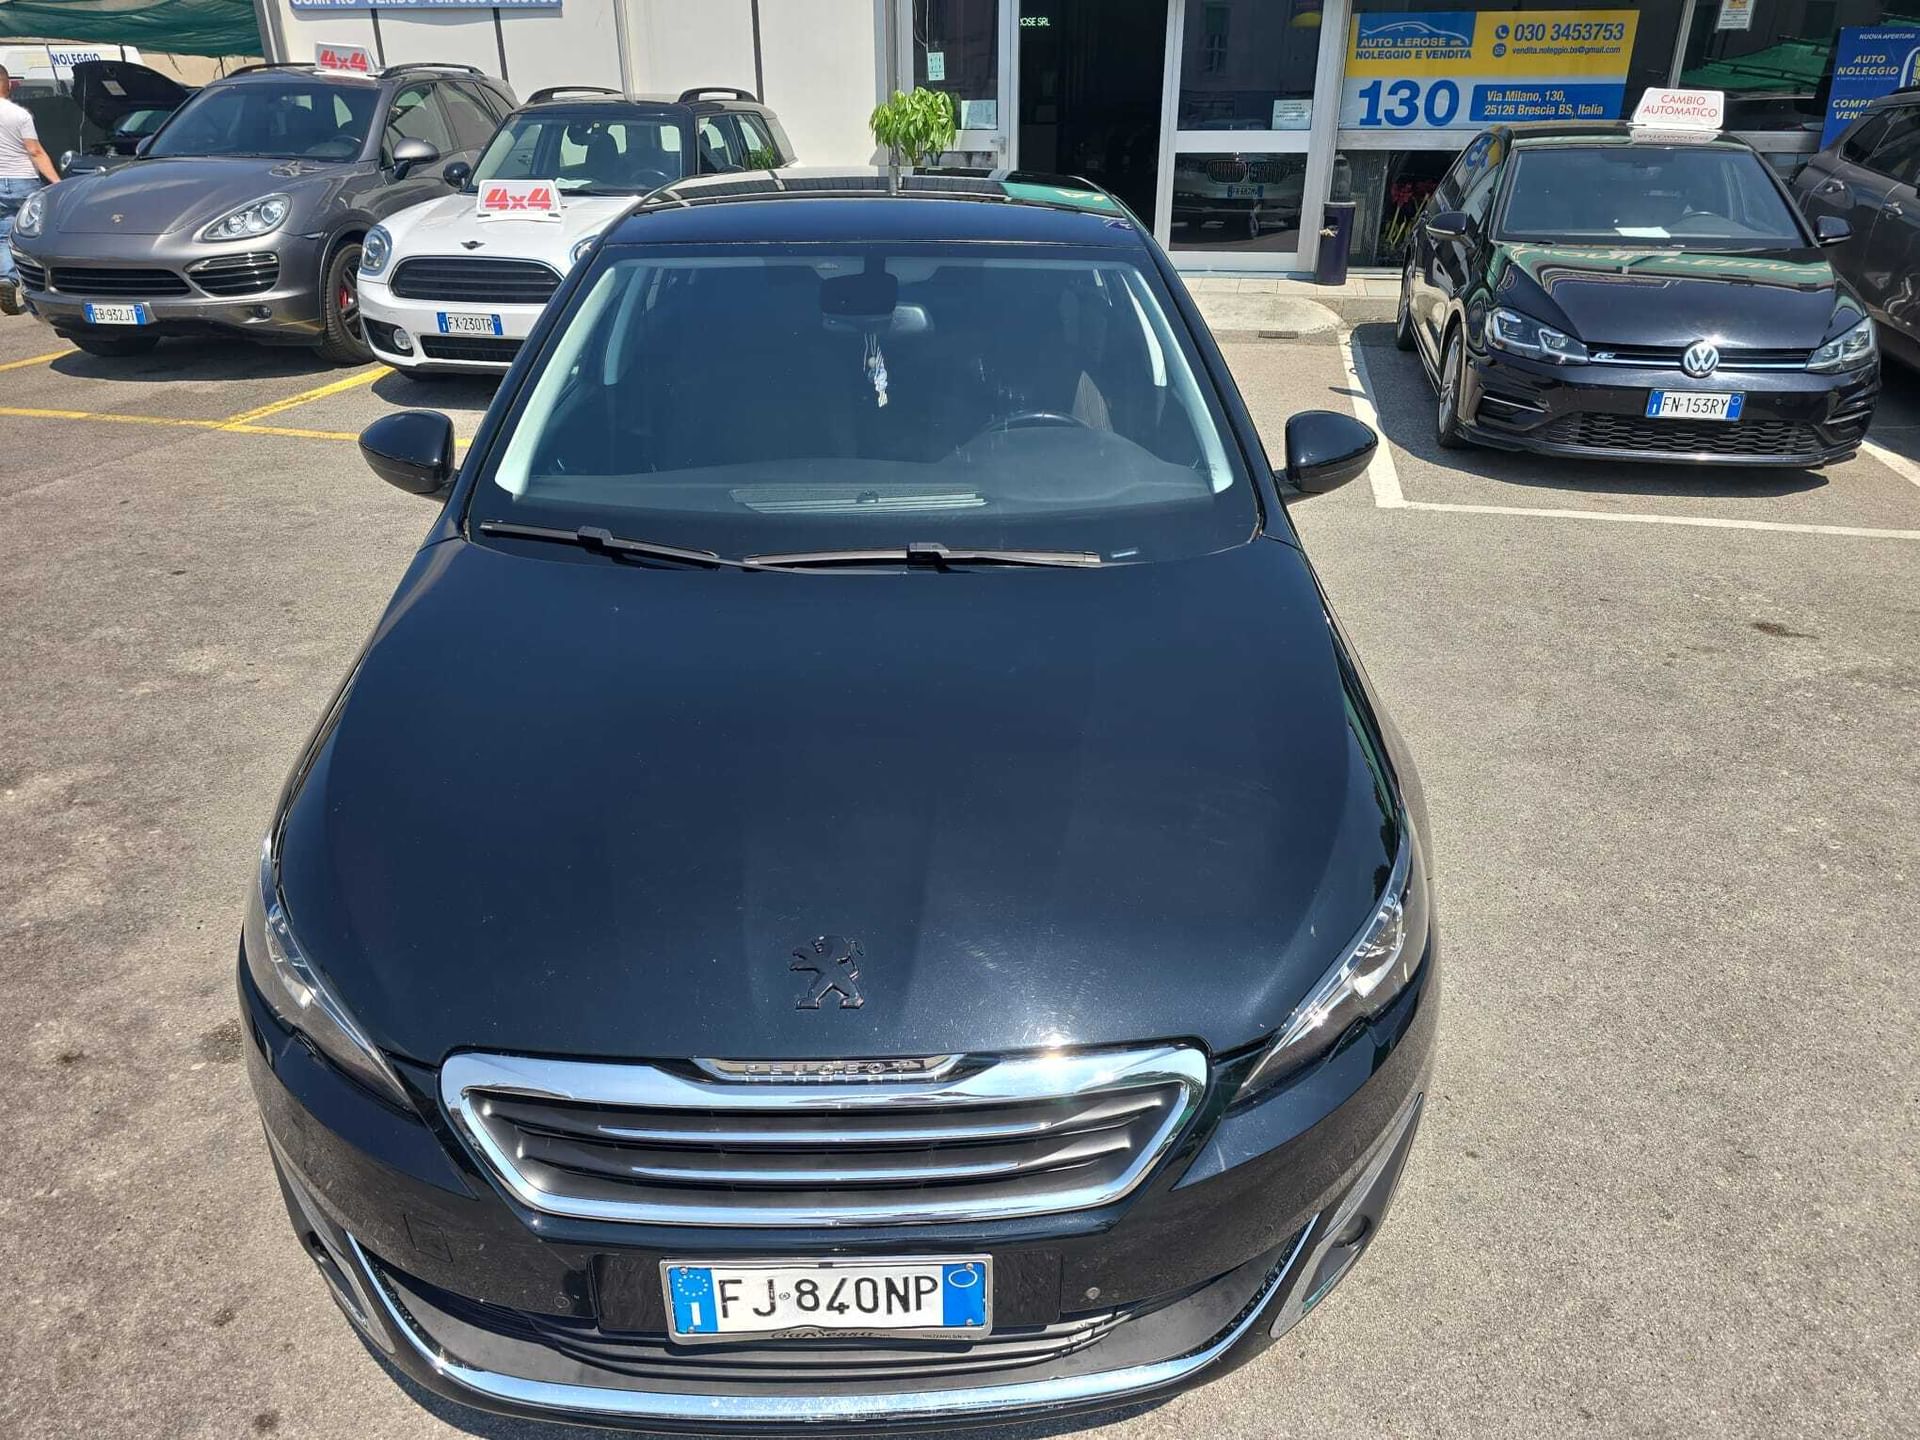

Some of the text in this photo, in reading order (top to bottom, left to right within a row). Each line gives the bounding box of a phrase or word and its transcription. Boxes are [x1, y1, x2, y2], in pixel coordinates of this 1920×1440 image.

[1037, 17, 1050, 26] SRL
[1514, 23, 1625, 41] 030 3453753
[1360, 38, 1393, 47] AUTO
[1397, 37, 1447, 47] LEROSE
[51, 53, 101, 65] NOLEGGIO
[320, 48, 368, 72] 4x4
[1356, 50, 1472, 60] NOLEGGIO E VENDITA
[1853, 55, 1886, 64] AUTO
[1837, 66, 1899, 75] NOLEGGIO
[1487, 90, 1566, 103] Via Milano, 130,
[1660, 94, 1706, 106] CAMBIO
[1359, 79, 1460, 127] 130
[1484, 104, 1604, 117] 25126 Brescia BS, Italia
[1643, 105, 1718, 118] AUTOMATICO
[1836, 111, 1862, 119] VEN
[484, 187, 552, 210] 4x4
[794, 1275, 939, 1315] 840NP
